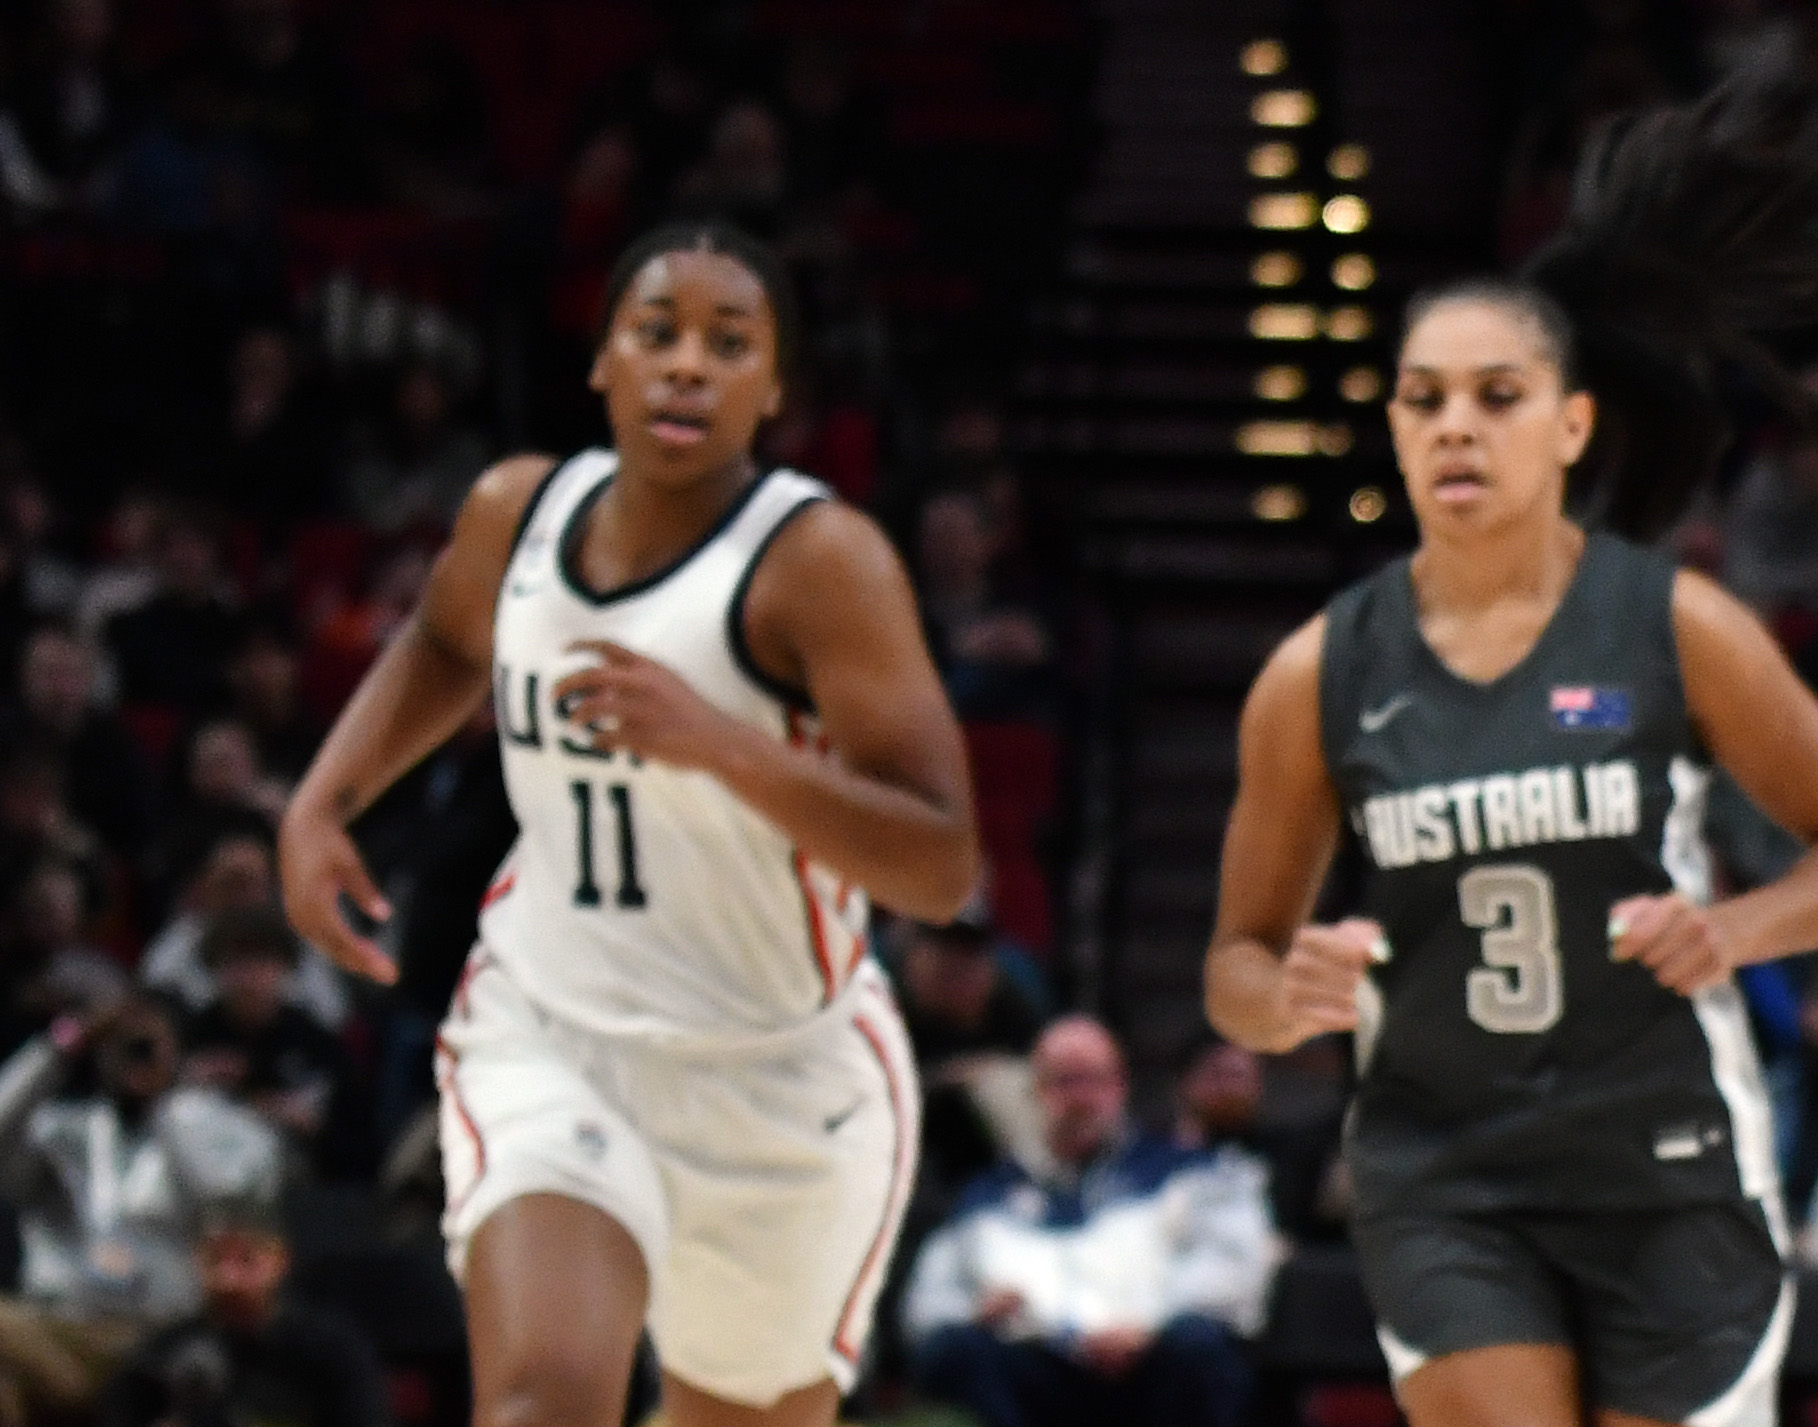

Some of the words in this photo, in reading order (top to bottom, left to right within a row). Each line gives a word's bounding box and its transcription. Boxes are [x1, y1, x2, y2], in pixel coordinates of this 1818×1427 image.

[498, 664, 642, 769] US
[569, 779, 646, 910] 11
[1457, 863, 1563, 1035] 3
